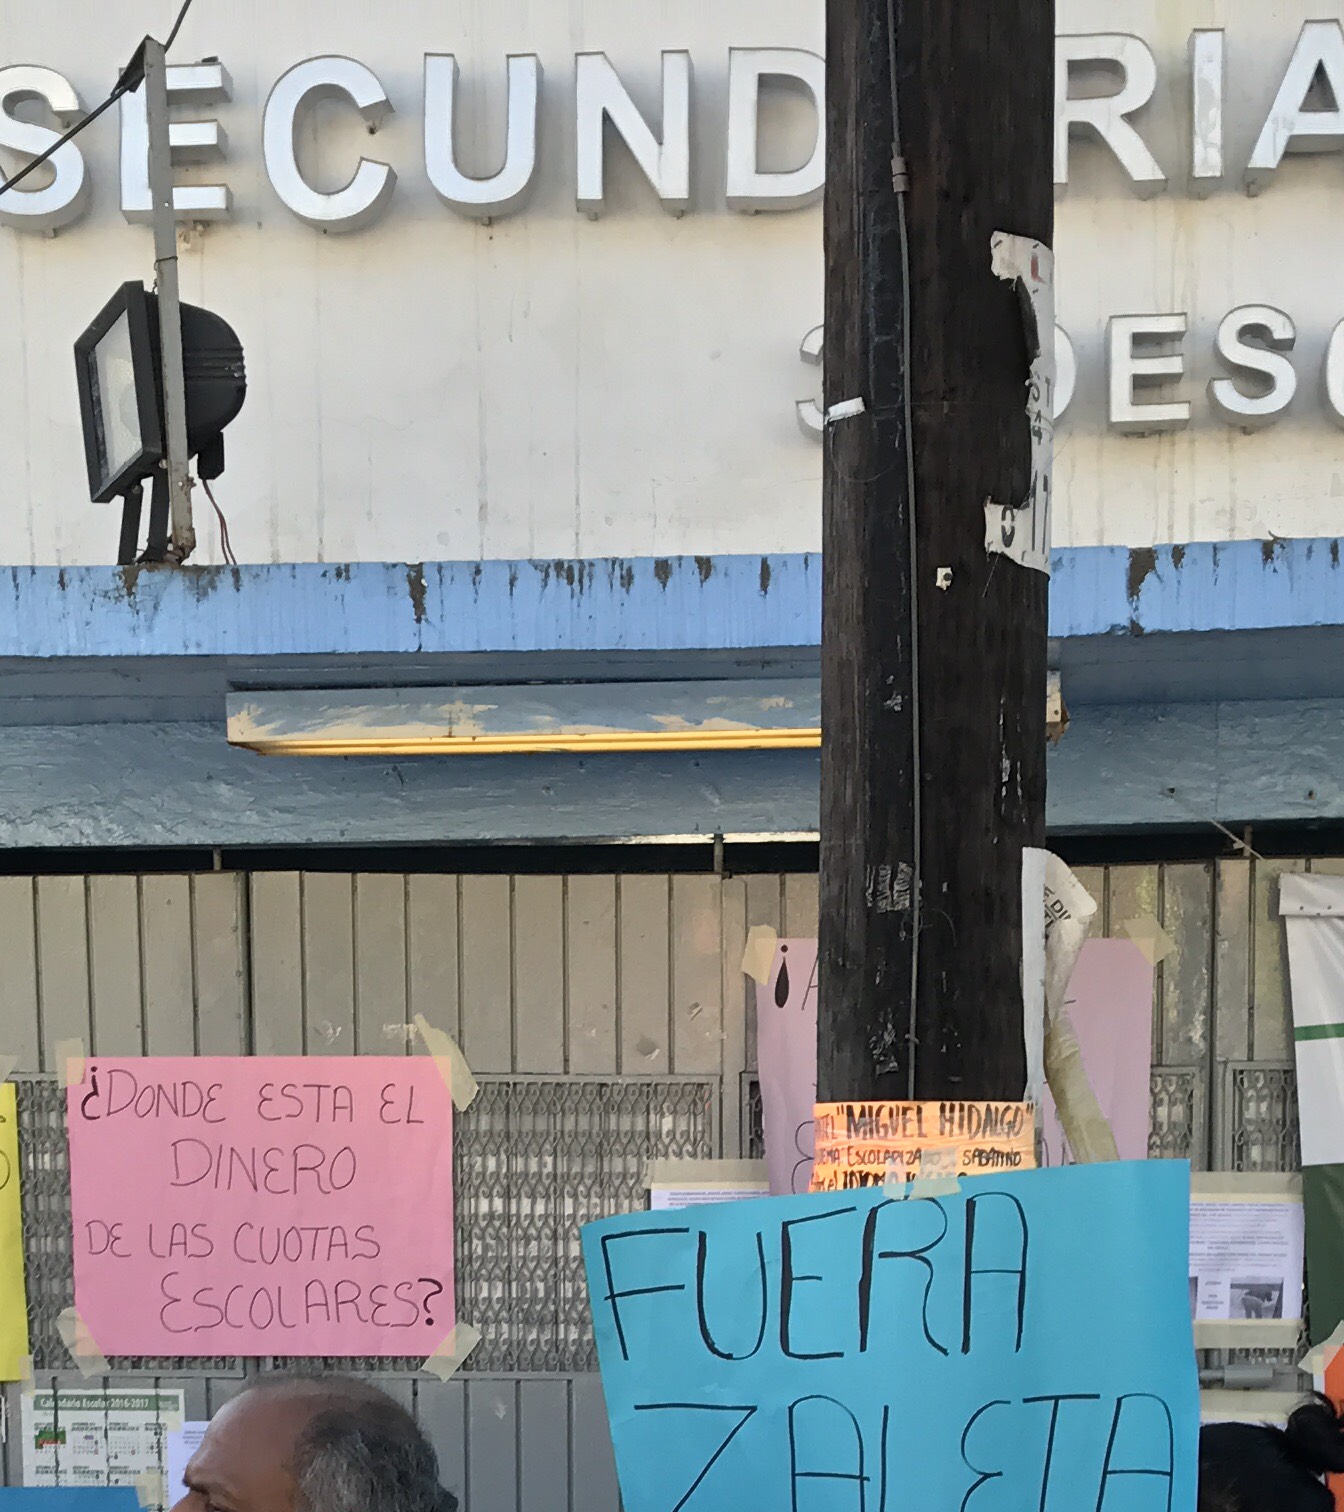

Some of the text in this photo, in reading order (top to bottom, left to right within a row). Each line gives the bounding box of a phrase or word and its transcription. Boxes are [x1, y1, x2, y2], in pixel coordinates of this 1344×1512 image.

[258, 1082, 355, 1124] ESTA
[379, 1082, 426, 1125] EL
[171, 1139, 358, 1196] DINERO
[86, 1219, 382, 1264] DE LAS CUOTAS
[159, 1270, 444, 1335] ESCOLARES?
[601, 1192, 1029, 1361] FUERA
